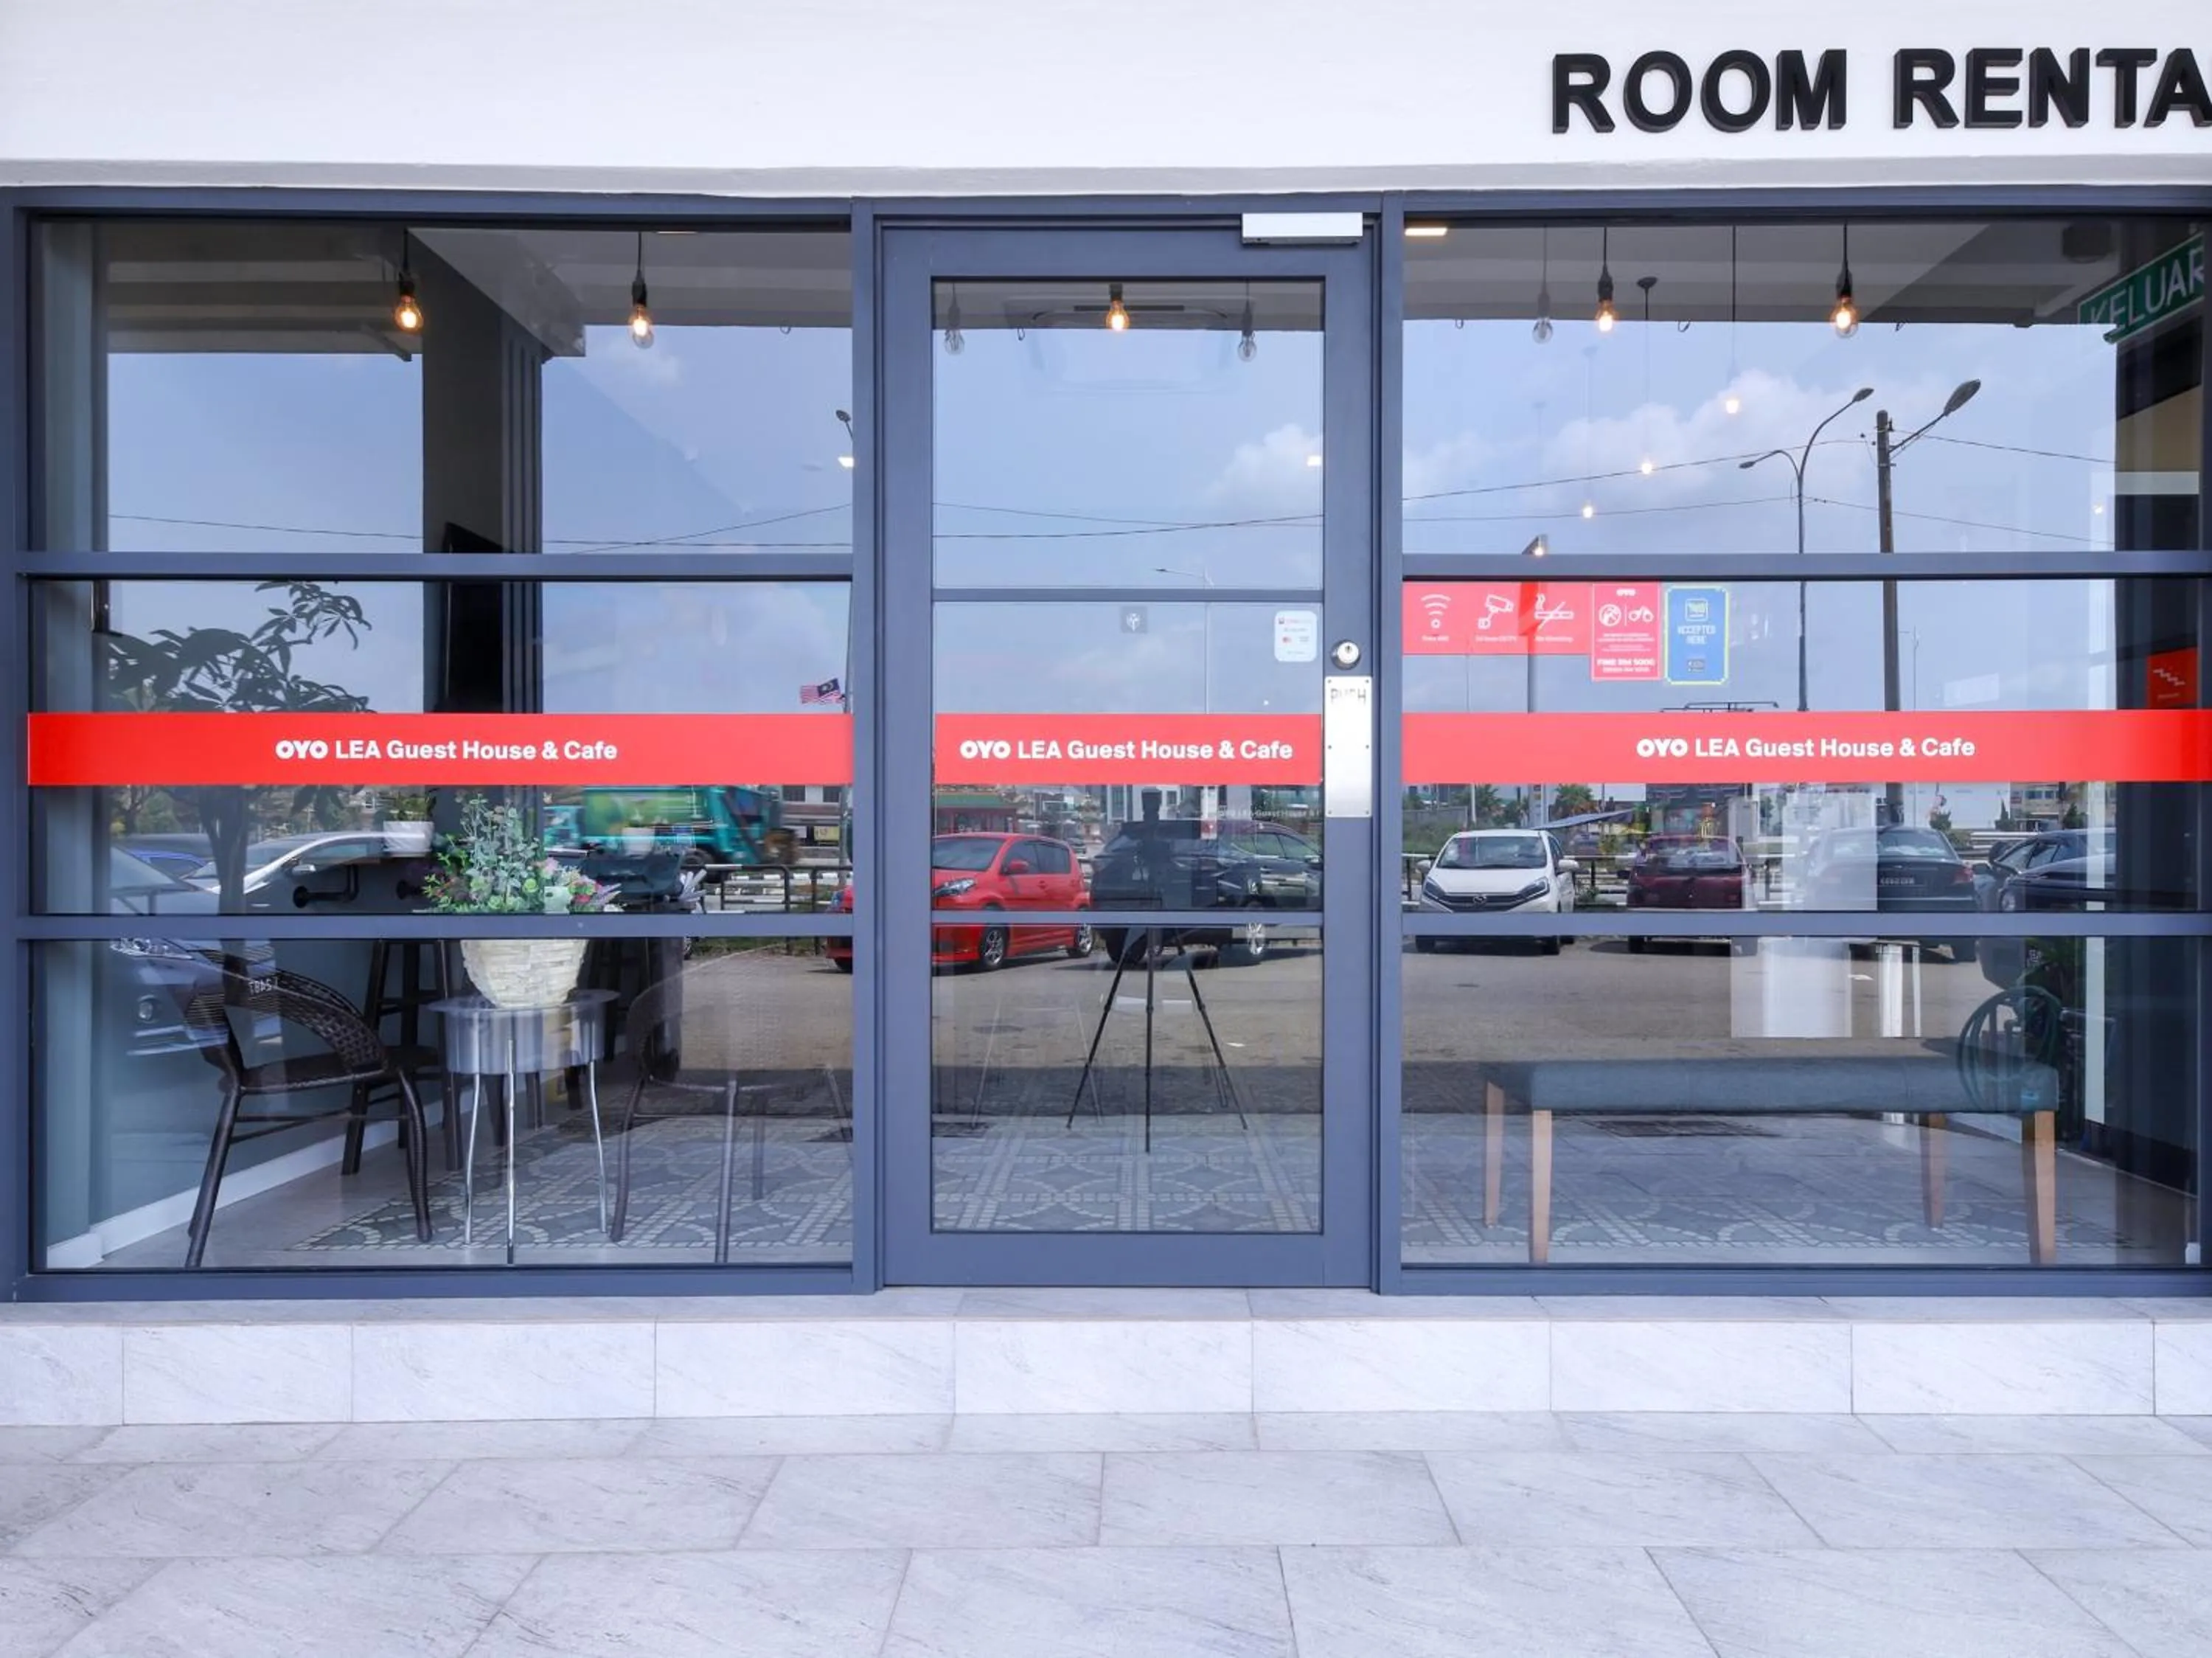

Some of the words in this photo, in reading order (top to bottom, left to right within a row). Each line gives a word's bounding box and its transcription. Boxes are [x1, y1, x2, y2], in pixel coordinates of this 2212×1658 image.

[1552, 49, 1847, 133] ROOM
[1893, 47, 2212, 129] RENTA
[276, 740, 328, 760] OYO
[335, 740, 381, 760] LEA
[387, 740, 456, 760] Guest
[463, 740, 536, 760] House
[541, 740, 558, 760] &
[564, 740, 617, 760] Cafe
[960, 740, 1011, 759] OYO
[1018, 740, 1062, 759] LEA
[1068, 740, 1135, 759] Guest
[1141, 740, 1213, 759] House
[1219, 740, 1234, 759] &
[1240, 740, 1293, 759] Cafe
[1636, 738, 1688, 757] OYO
[1695, 738, 1740, 757] LEA
[1745, 738, 1815, 757] Guest
[1820, 738, 1894, 757] House
[1899, 738, 1916, 757] &
[1921, 738, 1975, 757] Cafe
